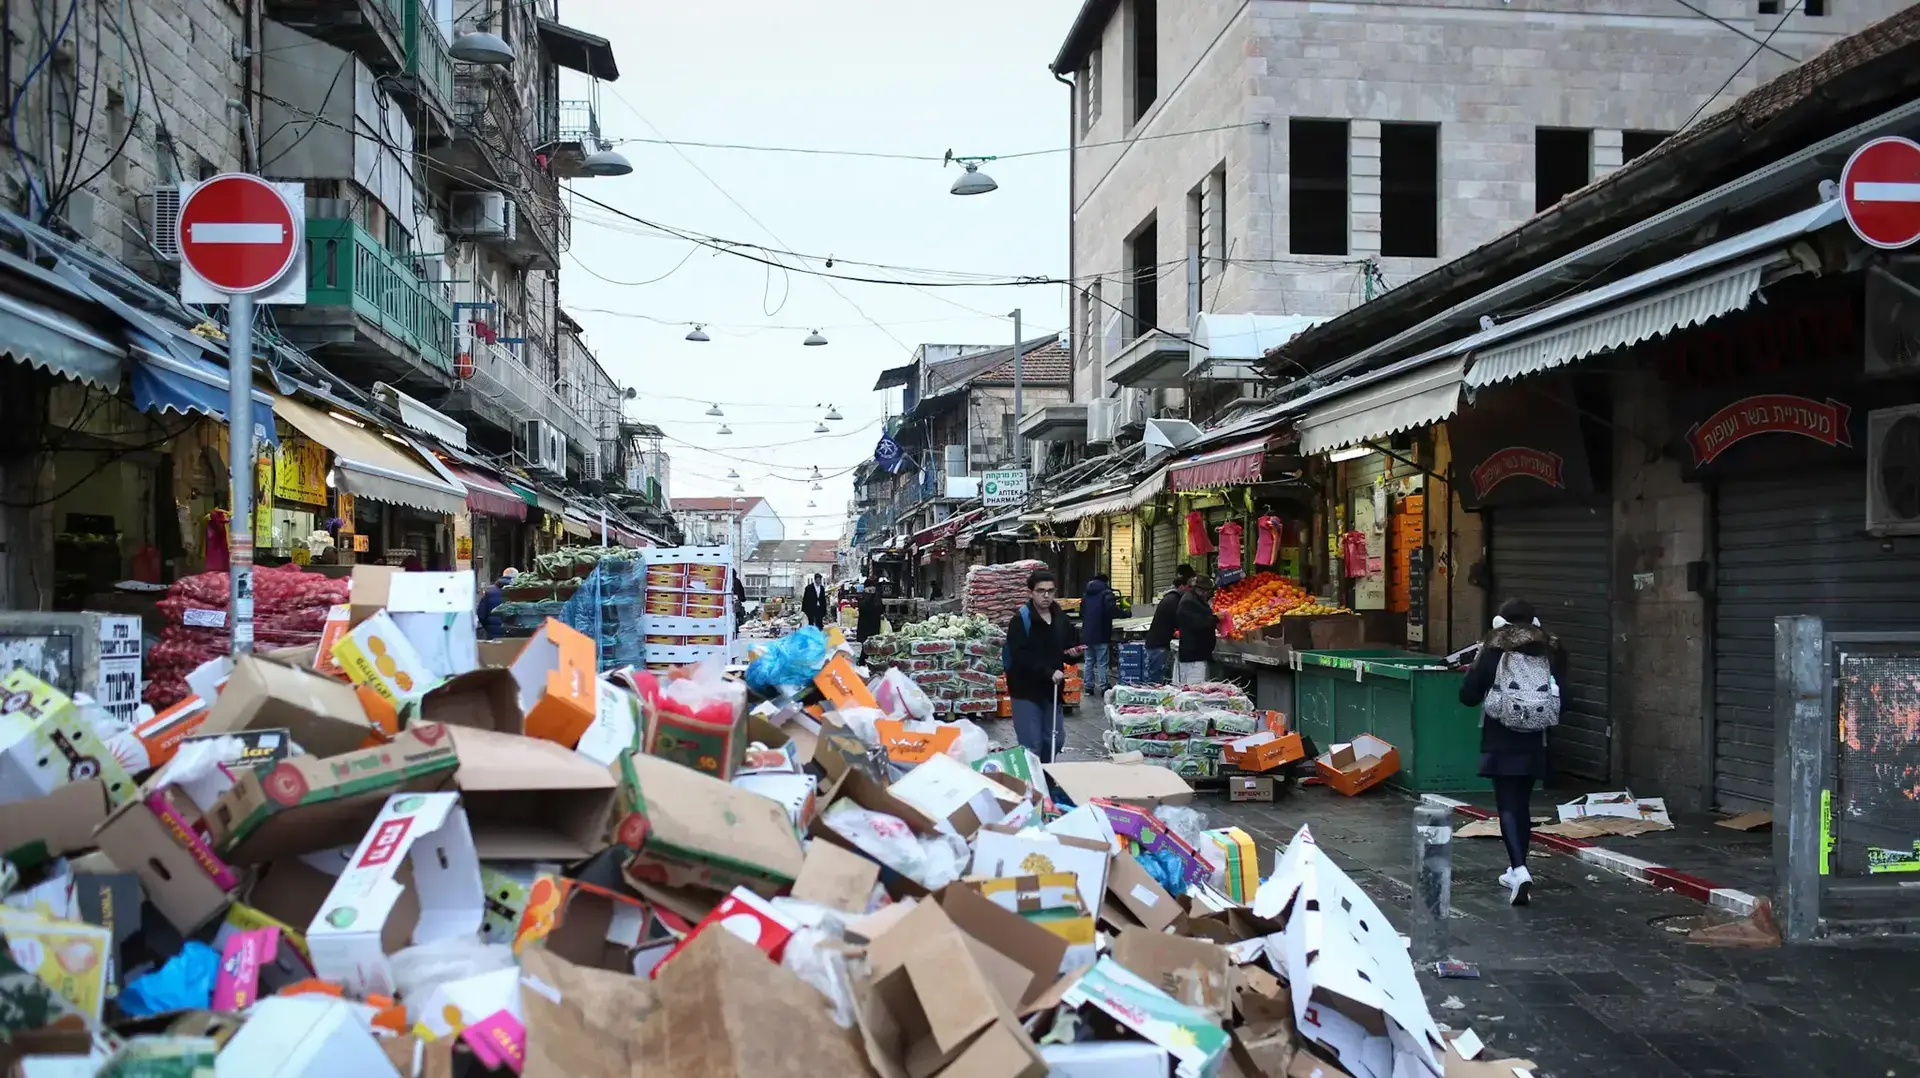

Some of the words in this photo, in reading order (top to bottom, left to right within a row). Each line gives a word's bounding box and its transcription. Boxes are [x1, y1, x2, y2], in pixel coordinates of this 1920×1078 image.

[1741, 407, 1770, 426] בשר
[1703, 414, 1740, 451] ועופות
[985, 472, 1010, 480] מרקחת
